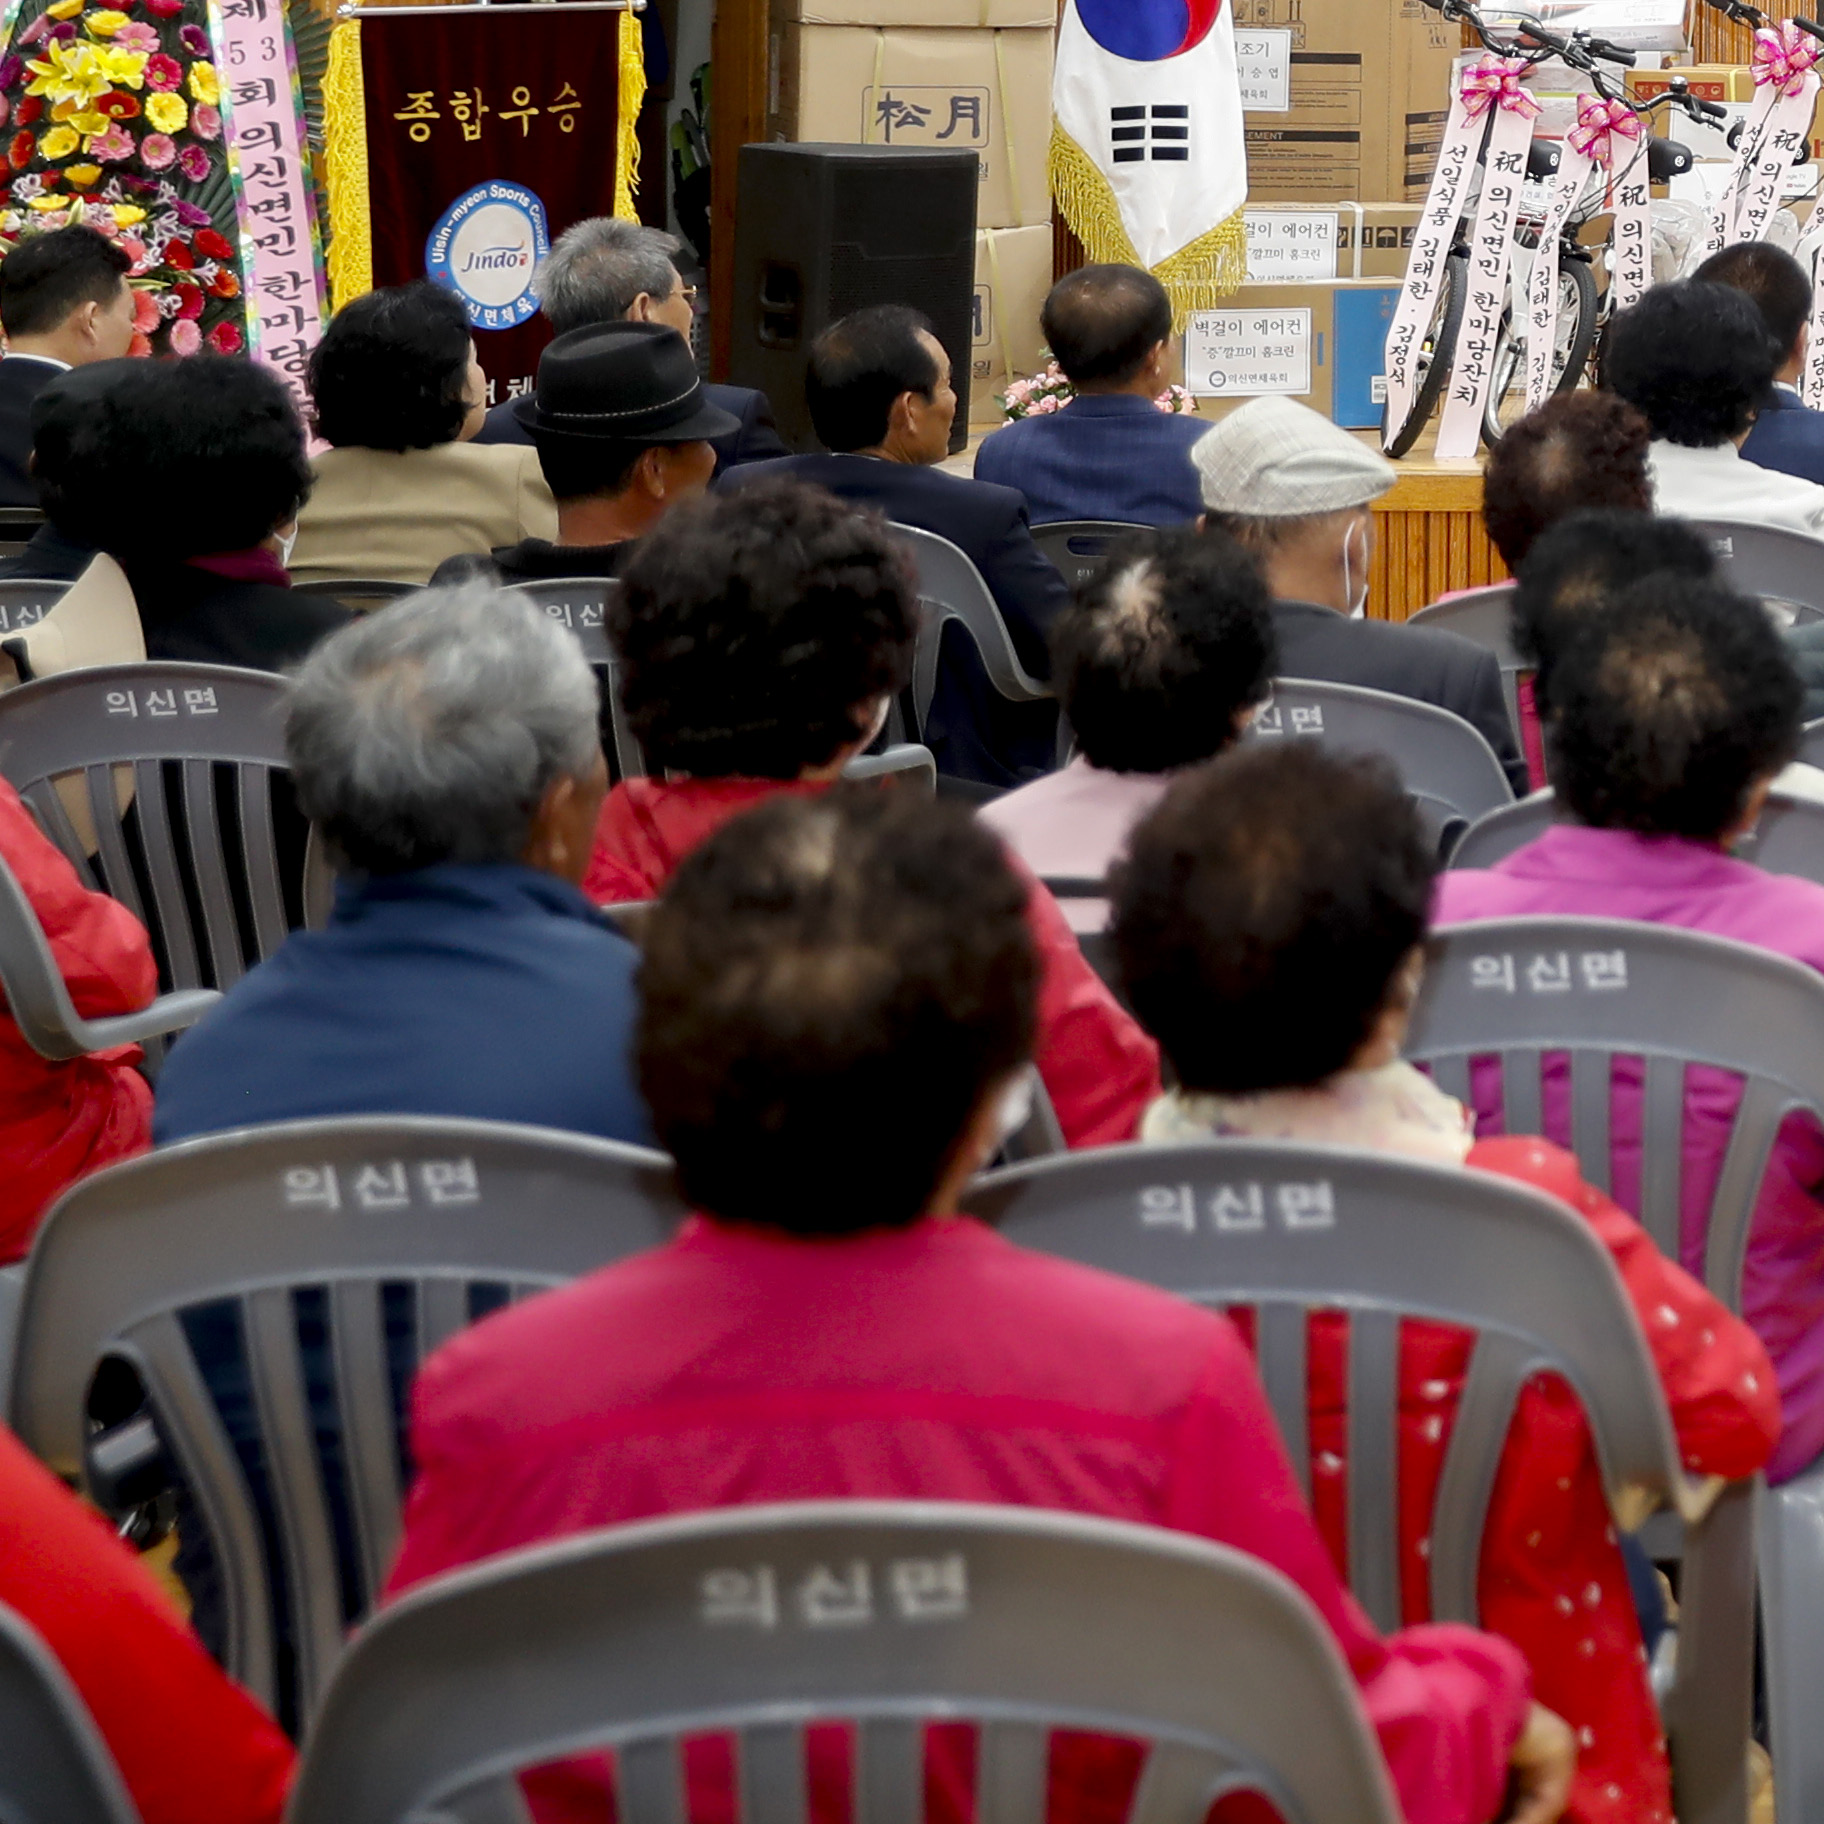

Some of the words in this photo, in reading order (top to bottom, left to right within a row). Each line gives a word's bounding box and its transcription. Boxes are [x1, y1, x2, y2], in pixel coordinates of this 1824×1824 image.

[393, 81, 583, 143] 종합우승
[874, 90, 981, 144] 松月
[1492, 150, 1525, 176] 祝
[1770, 128, 1802, 153] 祝
[237, 120, 298, 258] 의신면민
[1427, 143, 1470, 228] 선일식품
[1619, 184, 1649, 208] 祝
[431, 189, 488, 264] Uisin-myeon
[489, 184, 531, 208] Sports
[1282, 222, 1329, 239] 에어컨
[1476, 184, 1515, 279] 의신면민
[460, 251, 518, 273] Jindo
[1408, 237, 1442, 302] 김태한
[1531, 269, 1554, 330] 김태한
[1195, 319, 1244, 337] 벽걸이
[1253, 318, 1303, 337] 에어컨
[1452, 290, 1501, 411] 한마당잔치
[1227, 372, 1288, 385] 의신면체육회
[1388, 324, 1418, 389] 김정석
[104, 684, 220, 719] 의신면
[1471, 950, 1630, 993] 의신면
[282, 1157, 482, 1211] 의신면
[1139, 1180, 1340, 1233] 의신면
[696, 1554, 974, 1627] 의신면
